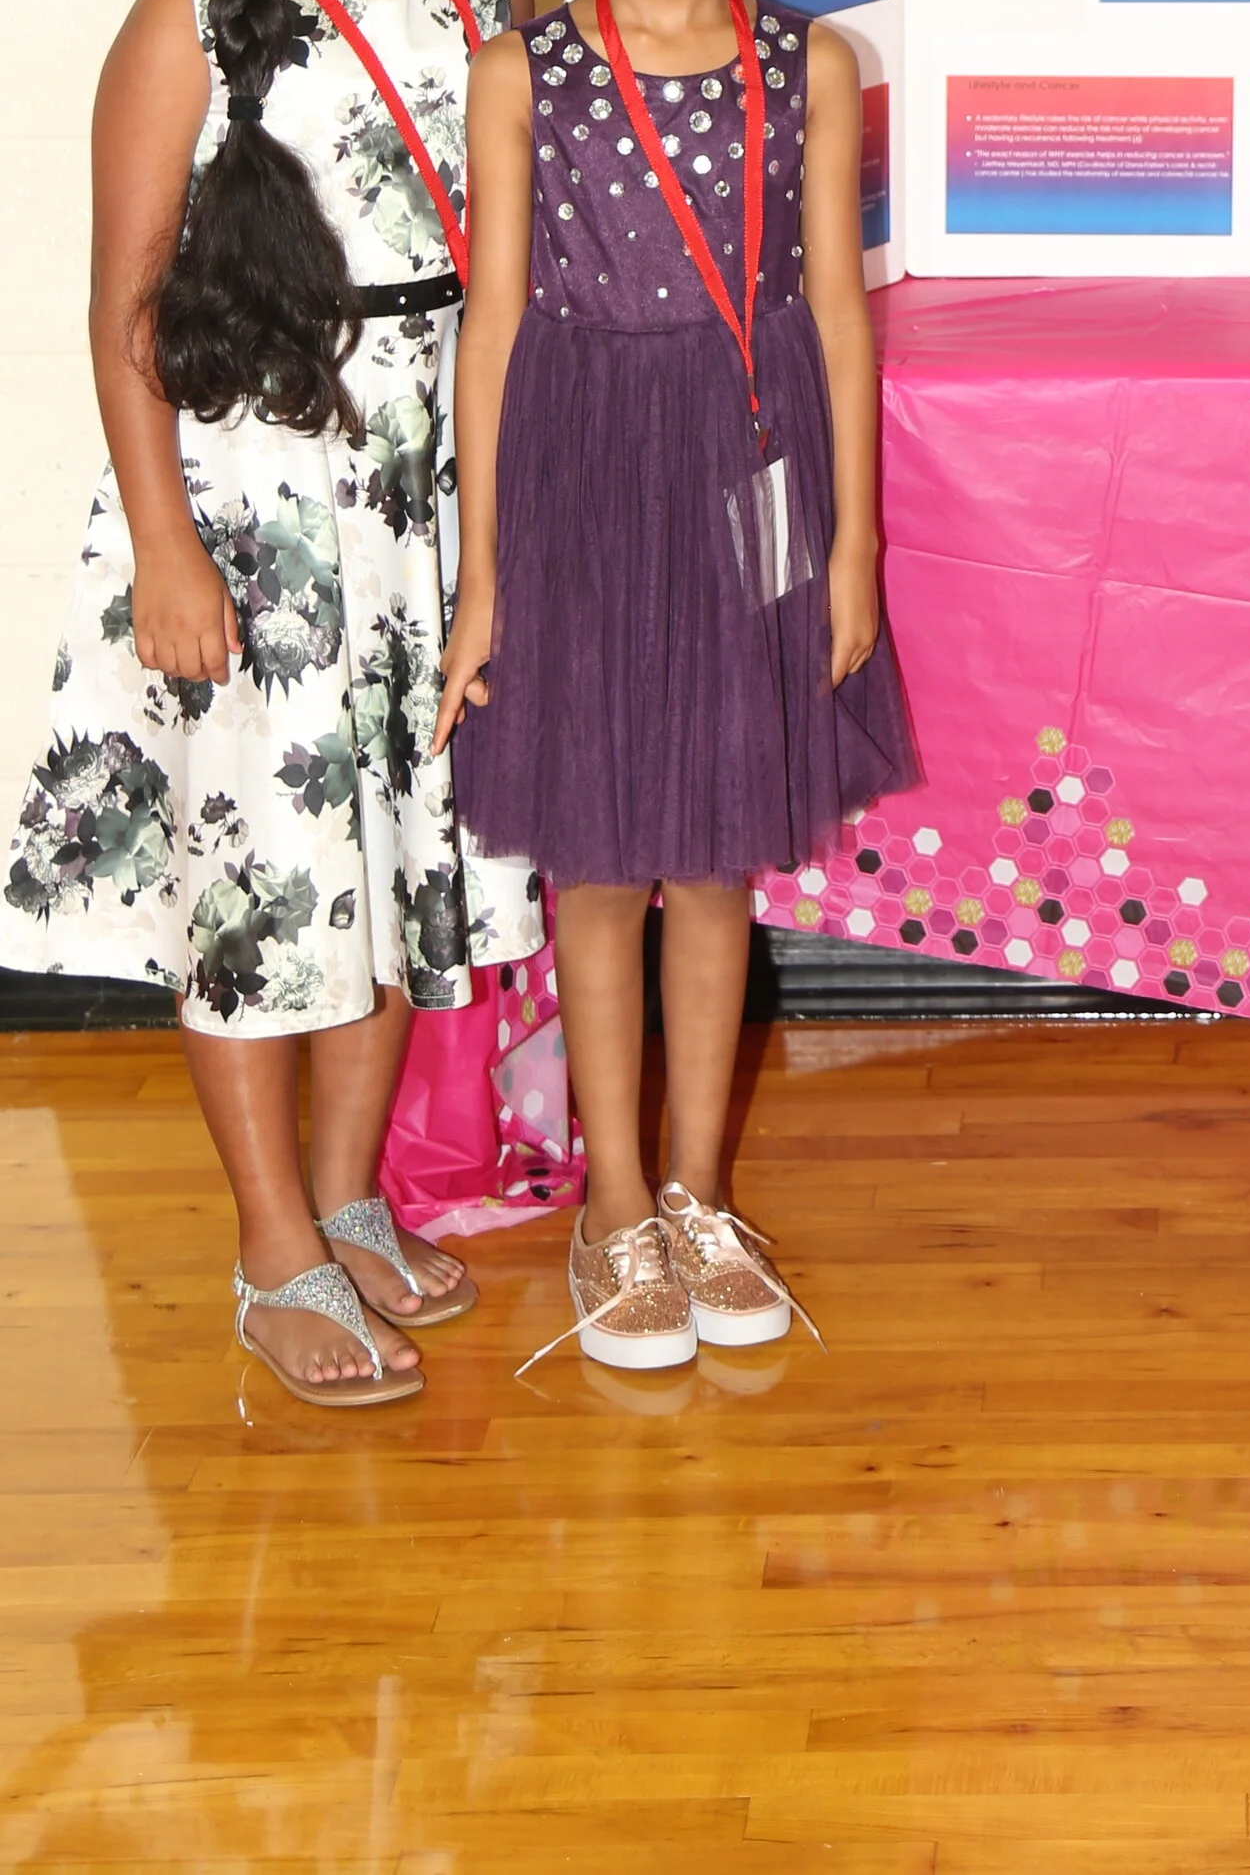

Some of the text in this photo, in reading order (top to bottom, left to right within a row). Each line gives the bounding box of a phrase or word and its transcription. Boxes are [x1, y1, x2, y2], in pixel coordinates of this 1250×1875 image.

[968, 81, 1080, 91] Lifestyle and Cancer
[988, 135, 1014, 143] having
[1062, 135, 1095, 144] following
